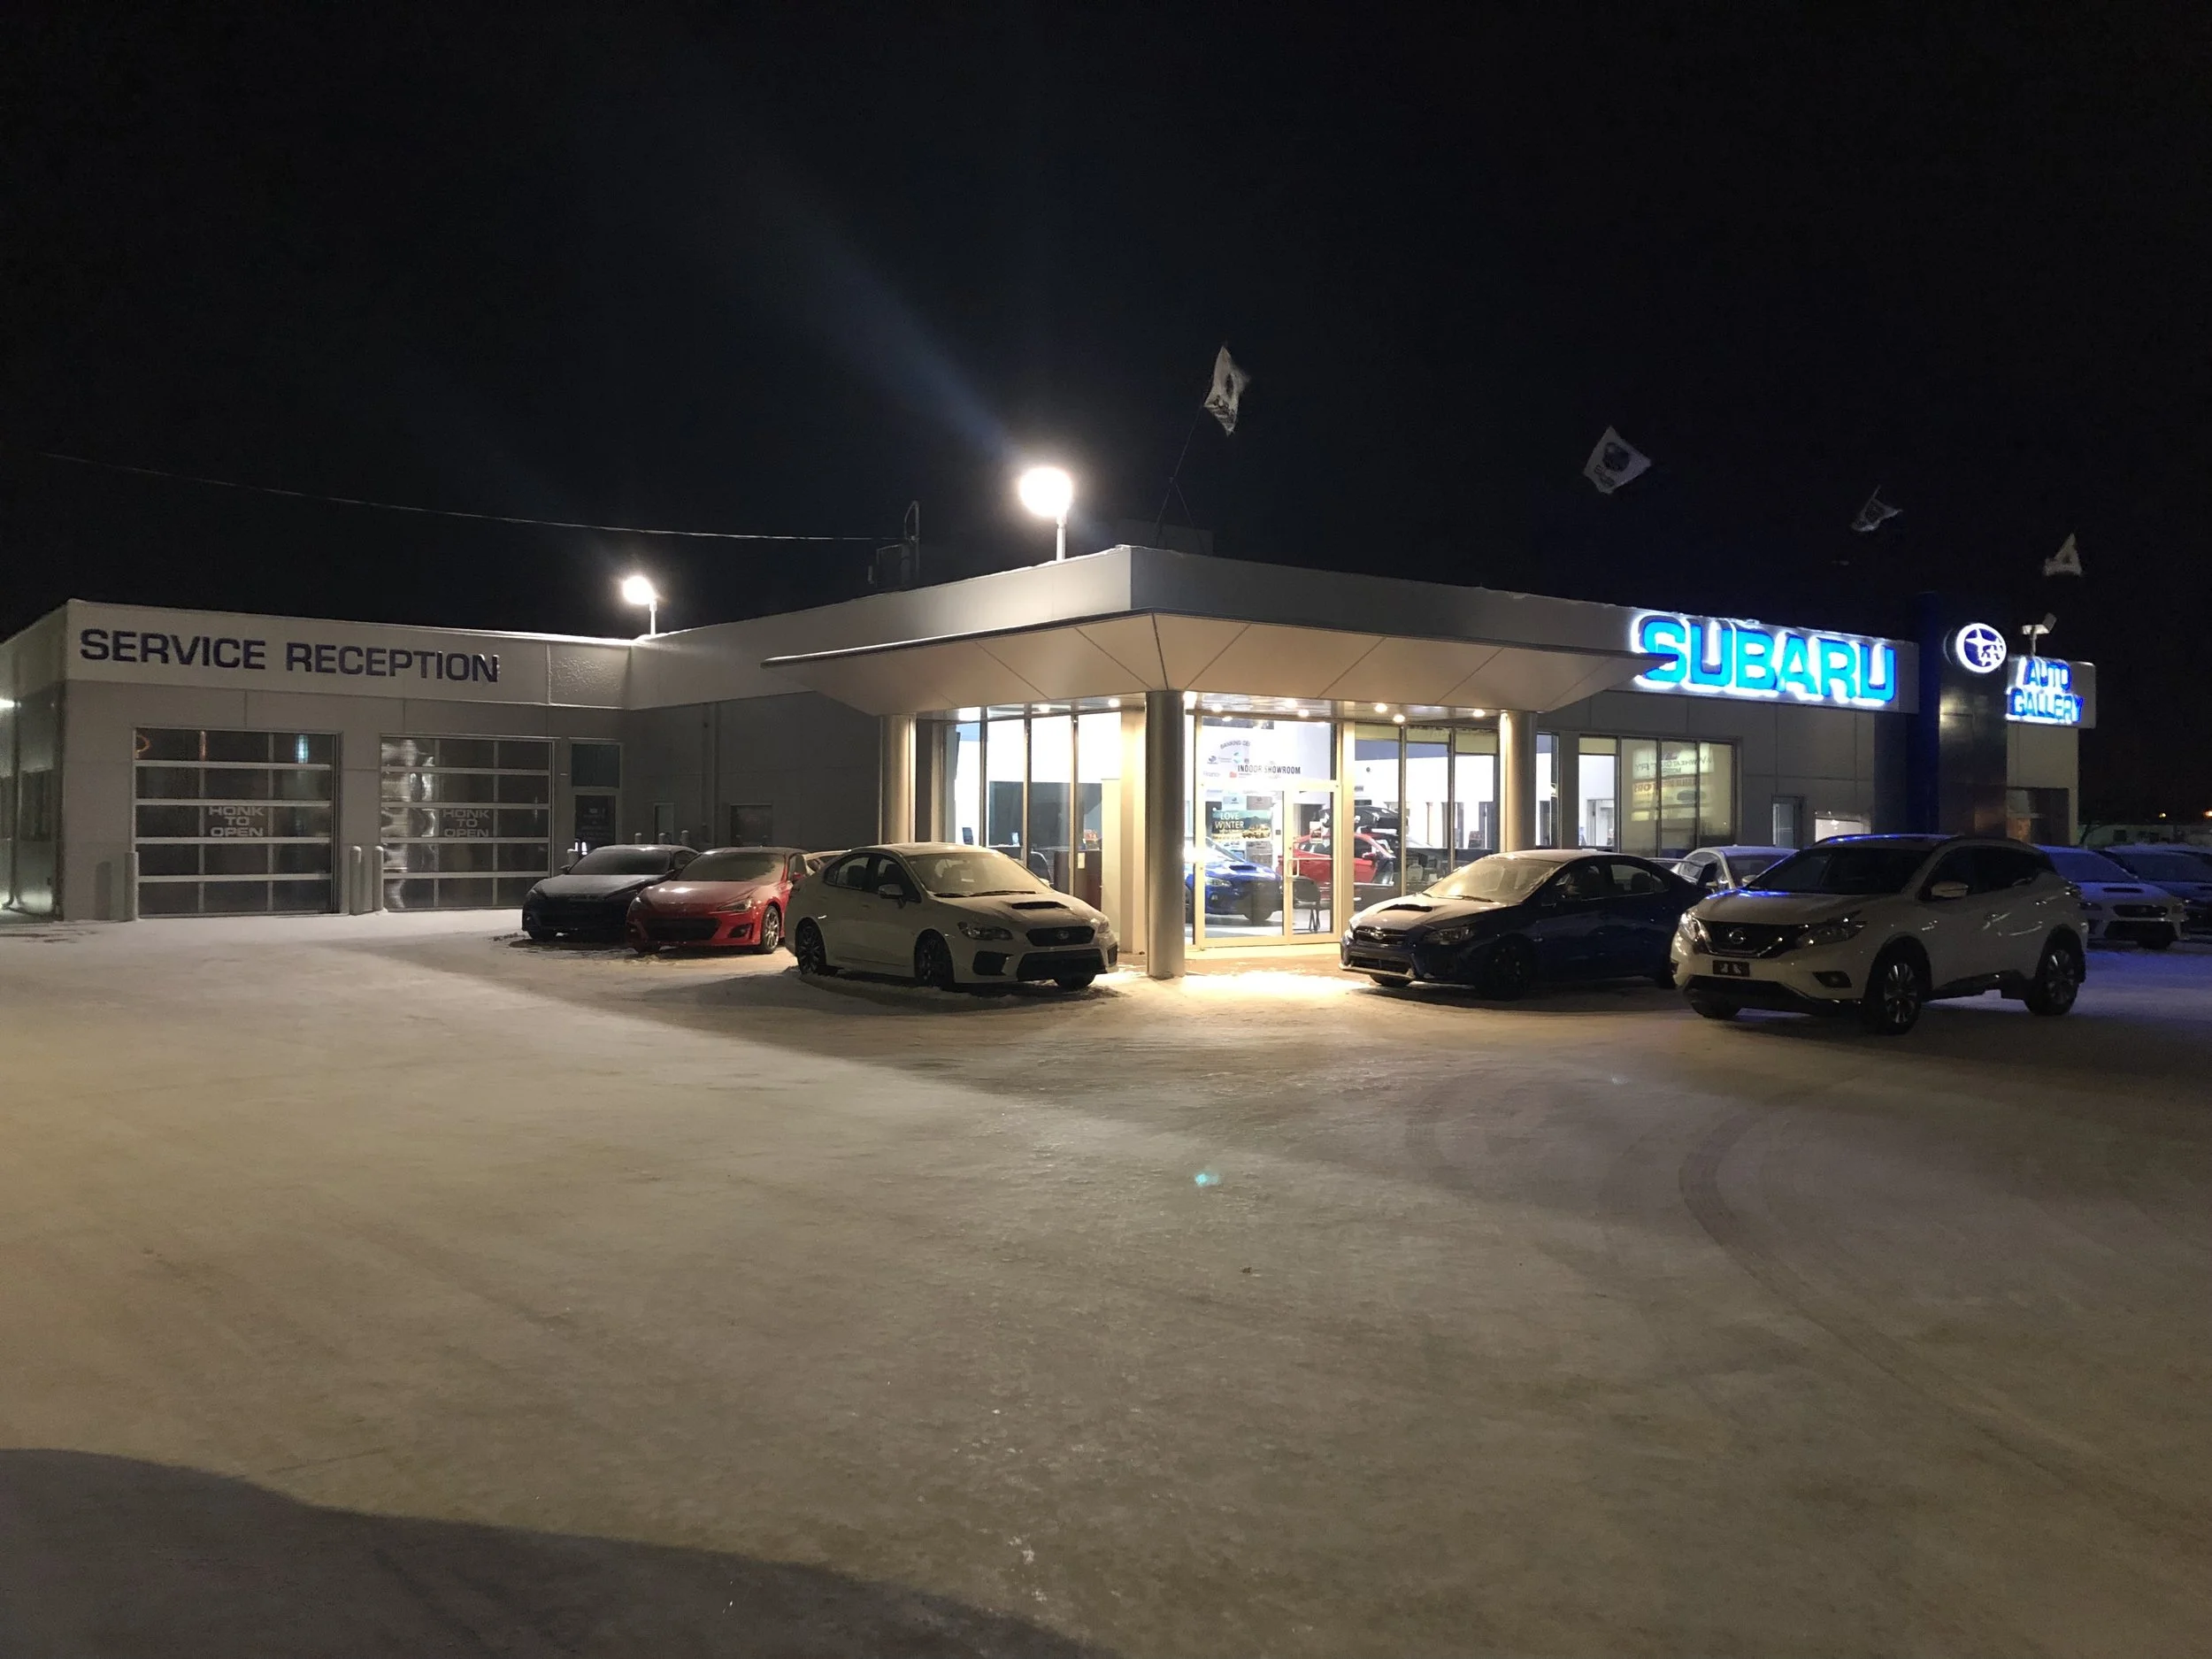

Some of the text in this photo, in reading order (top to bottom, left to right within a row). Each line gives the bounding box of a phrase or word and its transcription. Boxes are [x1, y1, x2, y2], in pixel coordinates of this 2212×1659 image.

[80, 628, 499, 682] SERVICE RECEPTION
[1639, 616, 1896, 703] SUBARU
[2023, 659, 2072, 690] AUTO
[2009, 687, 2084, 723] GALLERY
[1263, 765, 1301, 774] SHOWROOM
[208, 806, 265, 816] HONK
[442, 809, 490, 818] HONK
[224, 816, 250, 826] TO
[457, 818, 478, 827] TO
[1214, 820, 1245, 829] WINTER
[210, 826, 264, 837] OPEN
[444, 828, 489, 837] OPEN
